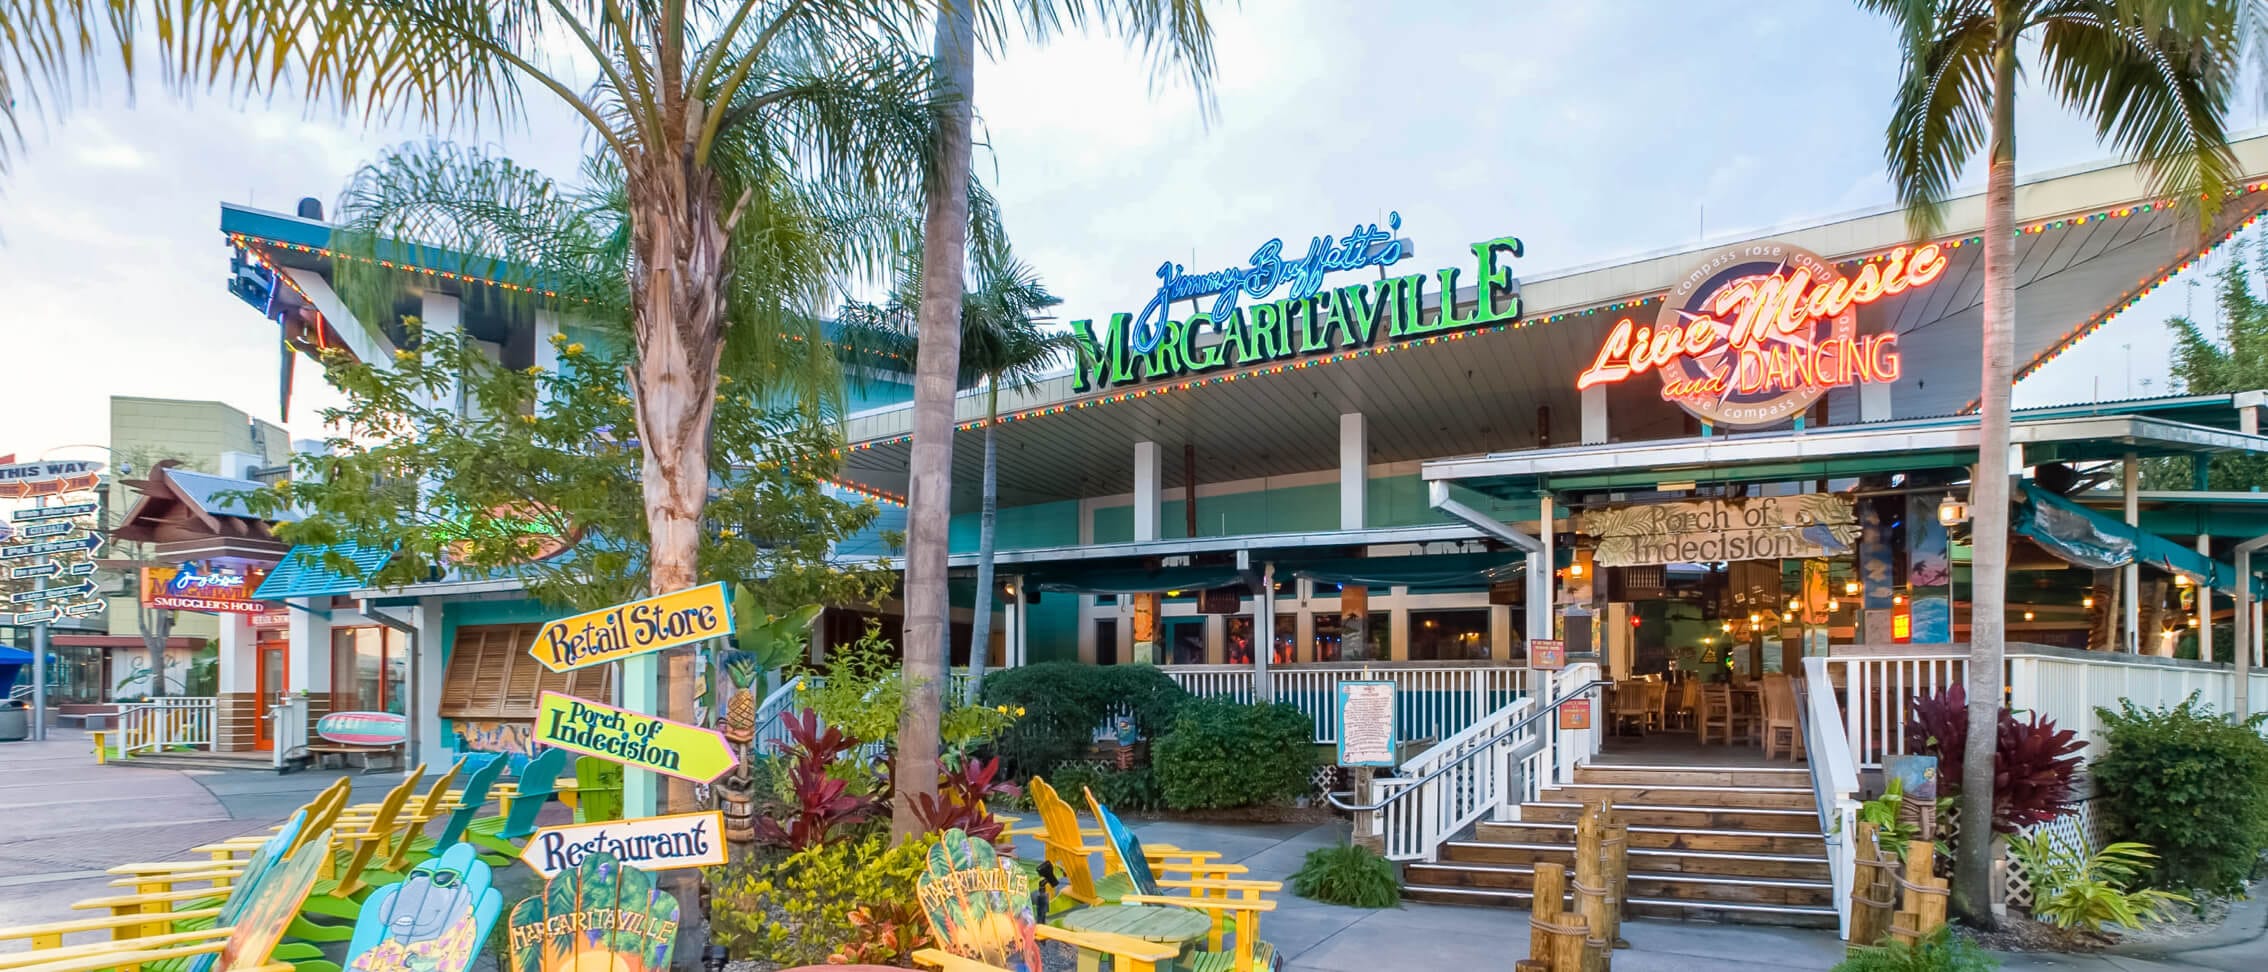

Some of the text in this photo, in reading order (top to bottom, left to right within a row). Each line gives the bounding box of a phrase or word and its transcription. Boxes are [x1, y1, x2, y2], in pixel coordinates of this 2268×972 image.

[1134, 210, 1401, 353] Jimmy Buffett's
[1676, 251, 1737, 296] compass
[1745, 245, 1782, 257] rose
[1069, 237, 1524, 393] MARGARITAVILLE
[1577, 318, 1719, 390] Live
[1715, 243, 1947, 348] Music
[1662, 331, 1901, 399] and DANCING
[1724, 398, 1795, 418] compass
[0, 462, 89, 479] THIS WAY
[1649, 497, 1779, 532] Porch of
[1631, 530, 1795, 565] Indecision
[154, 597, 264, 613] SMUGGLER'S HOLD
[545, 603, 718, 667] Retail Store
[549, 708, 681, 771] Indecision
[567, 702, 664, 740] Porch of
[539, 819, 709, 872] Restaurant
[920, 867, 1029, 912] MARGARITAVILLE
[511, 908, 678, 950] MARGARITAVILLE
